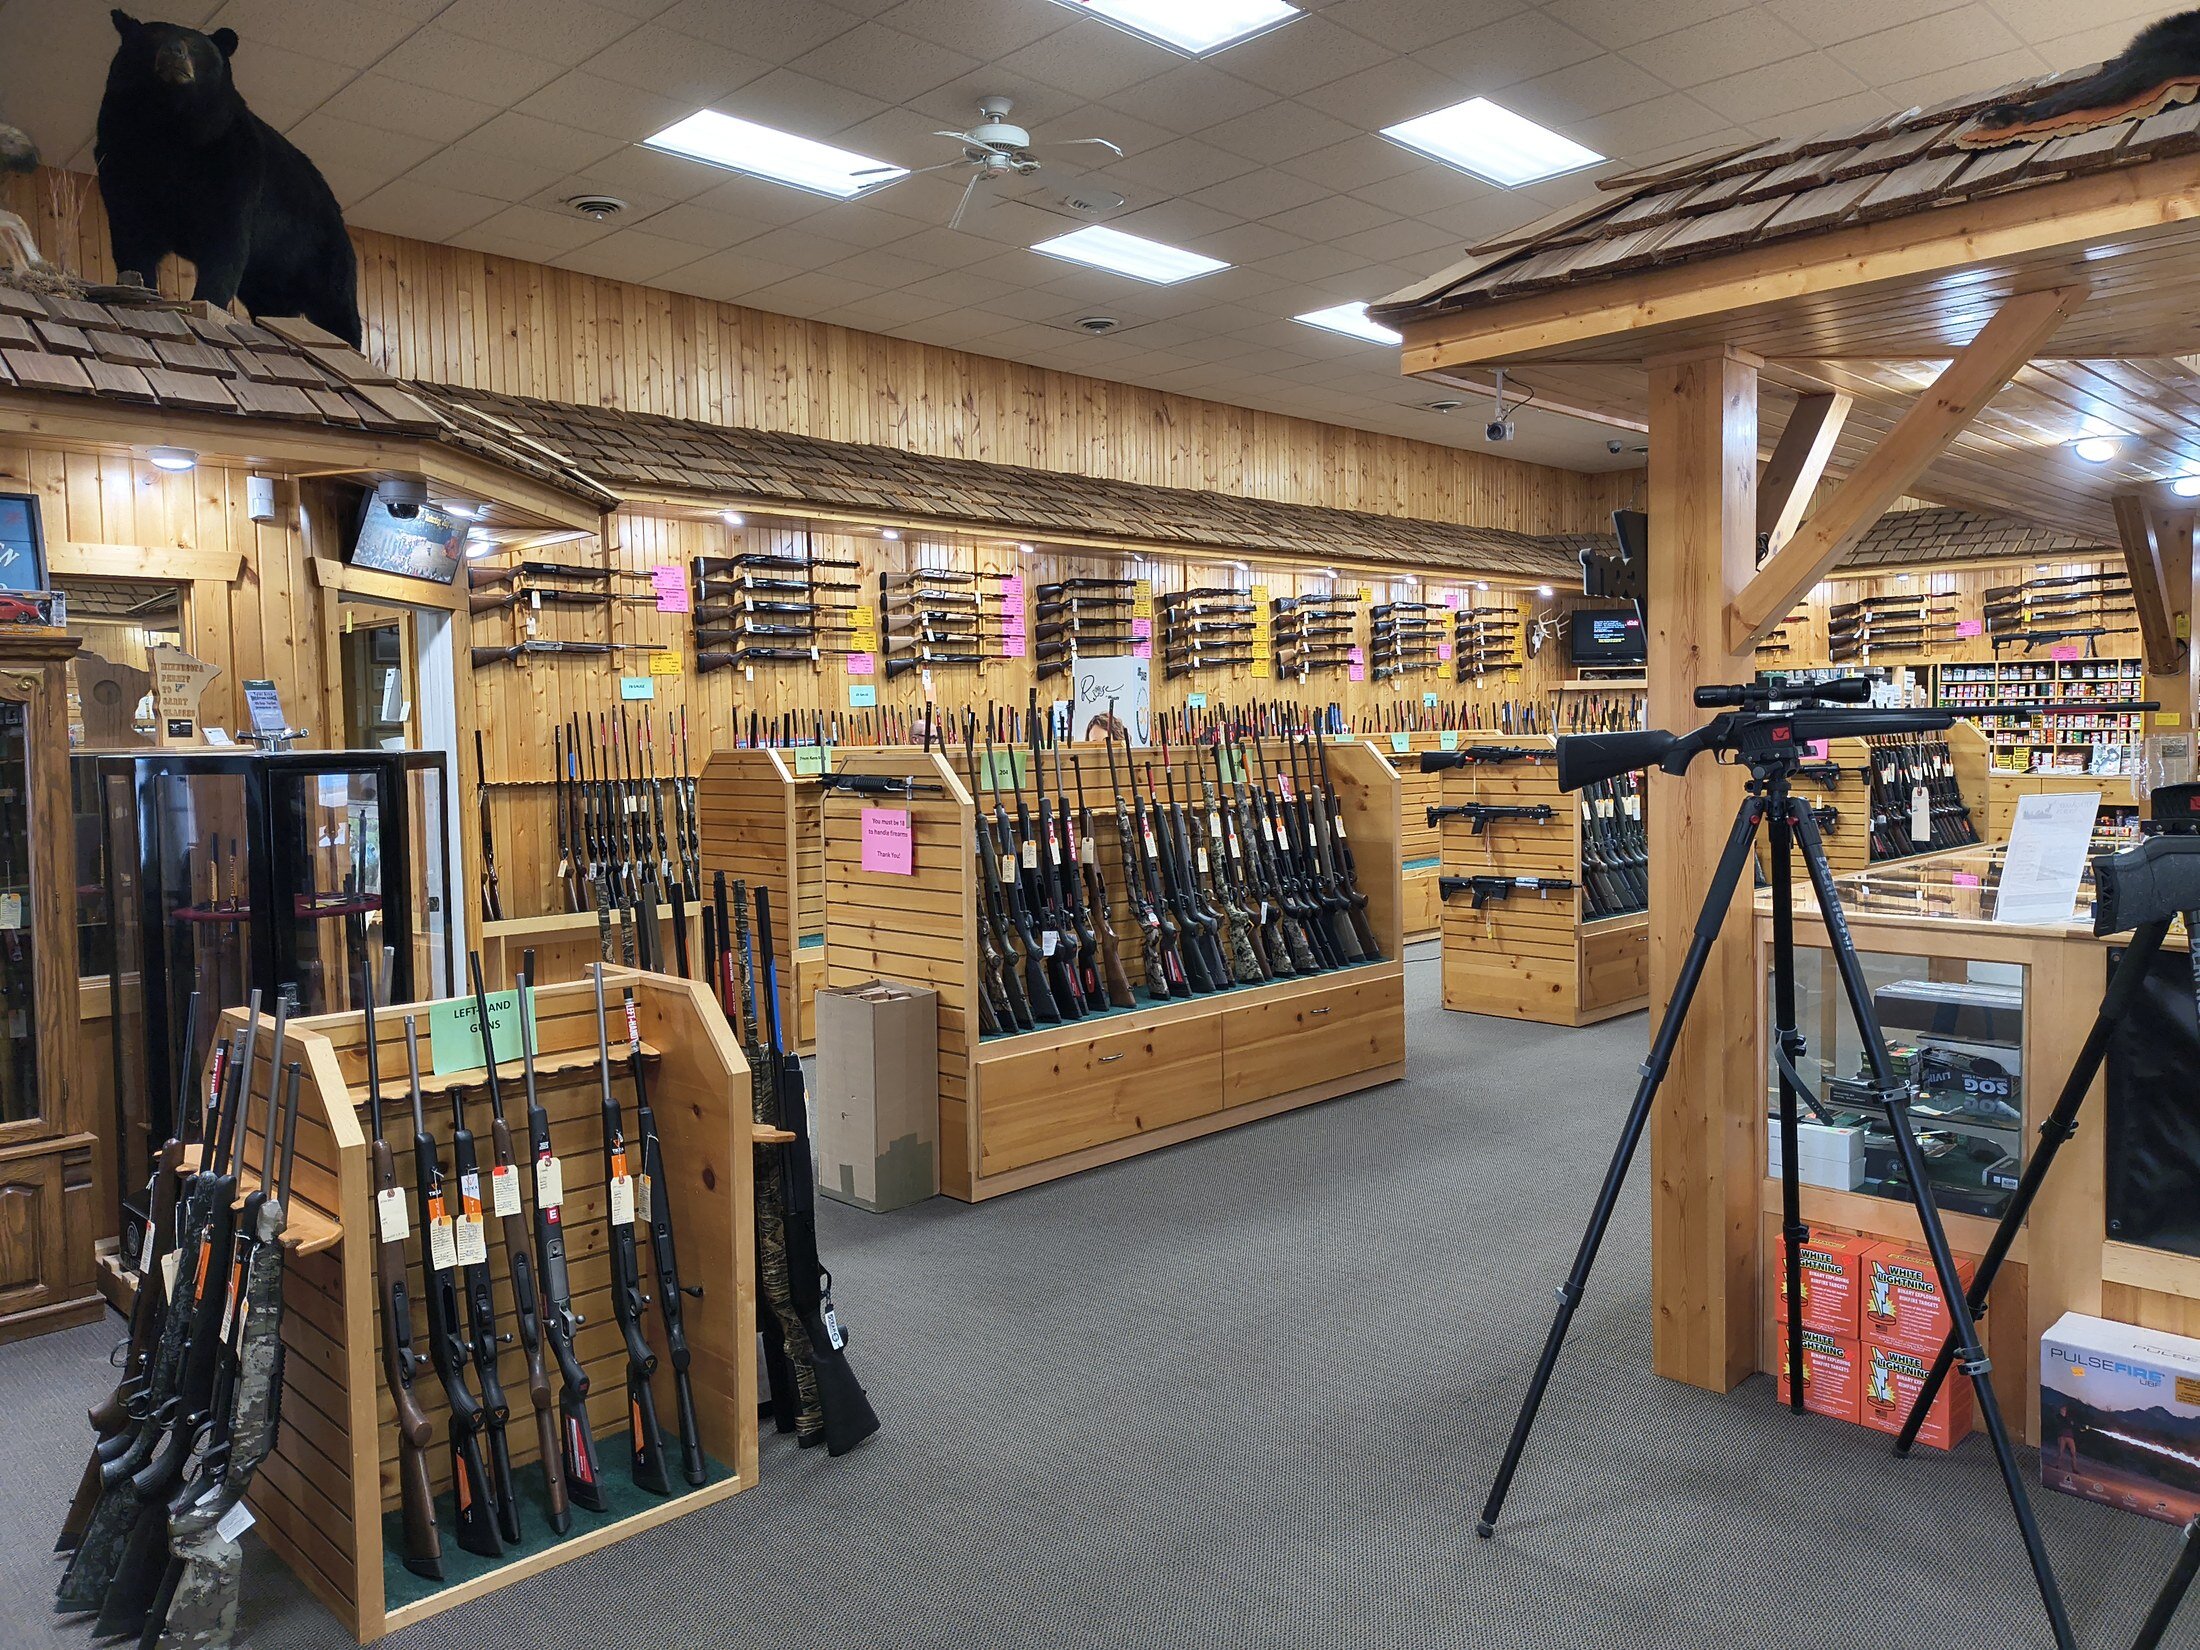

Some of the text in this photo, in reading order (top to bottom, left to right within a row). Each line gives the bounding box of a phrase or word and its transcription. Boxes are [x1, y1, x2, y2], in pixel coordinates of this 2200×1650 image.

[161, 663, 204, 673] MINNESOTA
[872, 818, 881, 826] You
[890, 830, 908, 838] firearms
[454, 1000, 511, 1019] LEFT-AND
[1964, 1079, 2008, 1094] SOG
[1800, 1249, 1833, 1263] WHITE
[1800, 1258, 1843, 1275] GHTNING
[1889, 1265, 1924, 1281] WHITE
[1876, 1273, 1935, 1293] LIGHTNING
[1802, 1331, 1834, 1345] WHITE
[1802, 1340, 1845, 1357] GHTNING
[1889, 1351, 1922, 1368] WHITE
[2051, 1348, 2163, 1382] PULSEFIRE
